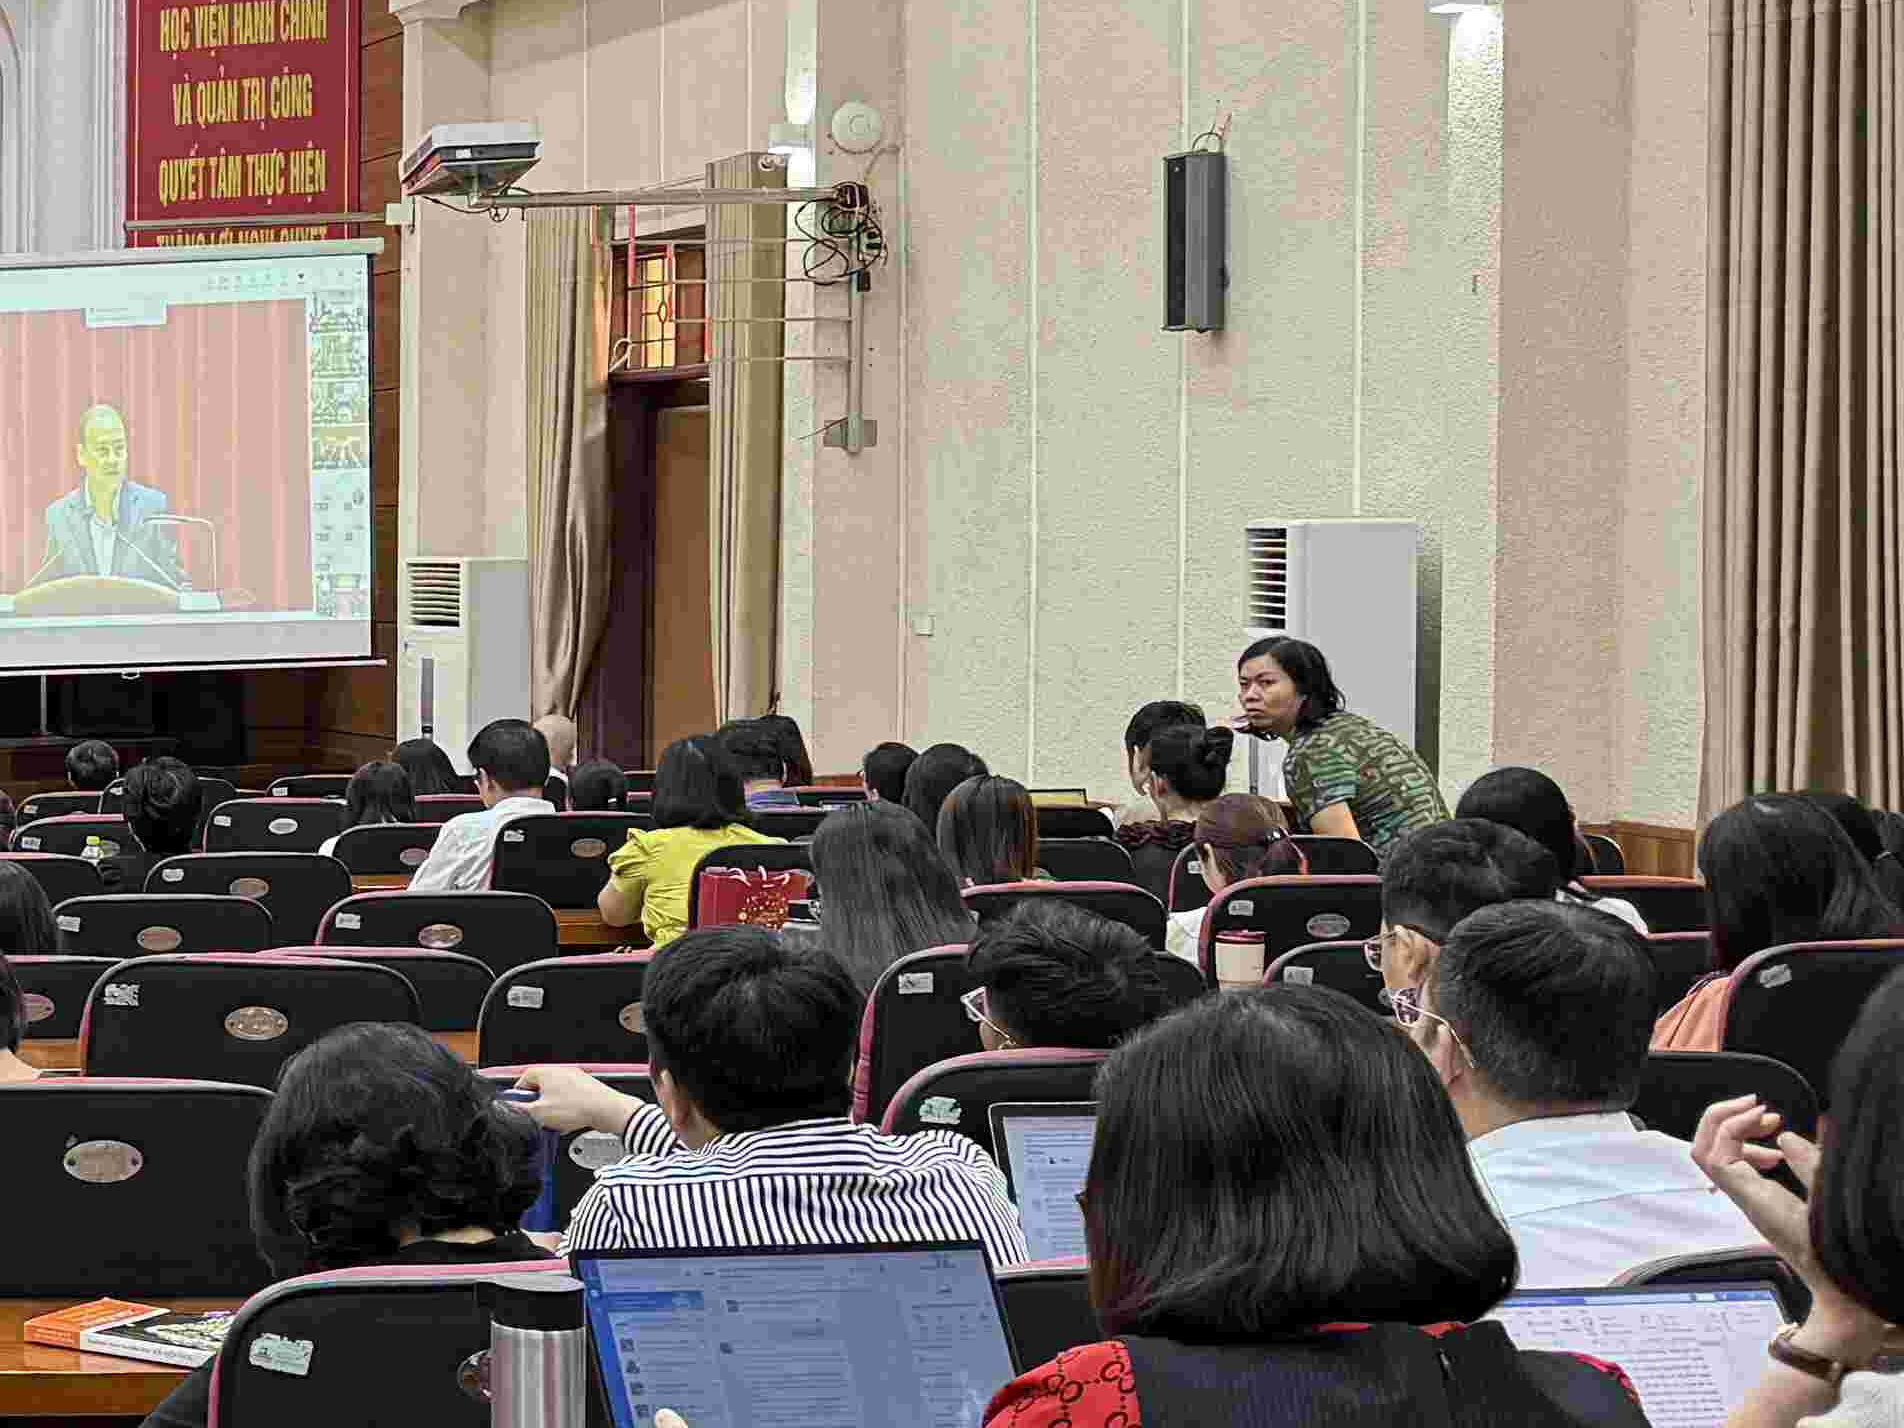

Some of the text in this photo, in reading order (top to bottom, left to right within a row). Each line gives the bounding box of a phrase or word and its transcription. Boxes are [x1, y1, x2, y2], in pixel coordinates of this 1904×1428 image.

[160, 6, 191, 59] HỌC
[173, 65, 313, 130] VÀ QUẢN TRỊ CÔNG
[159, 141, 327, 207] QUYẾT TÂM THỰC HIỆN
